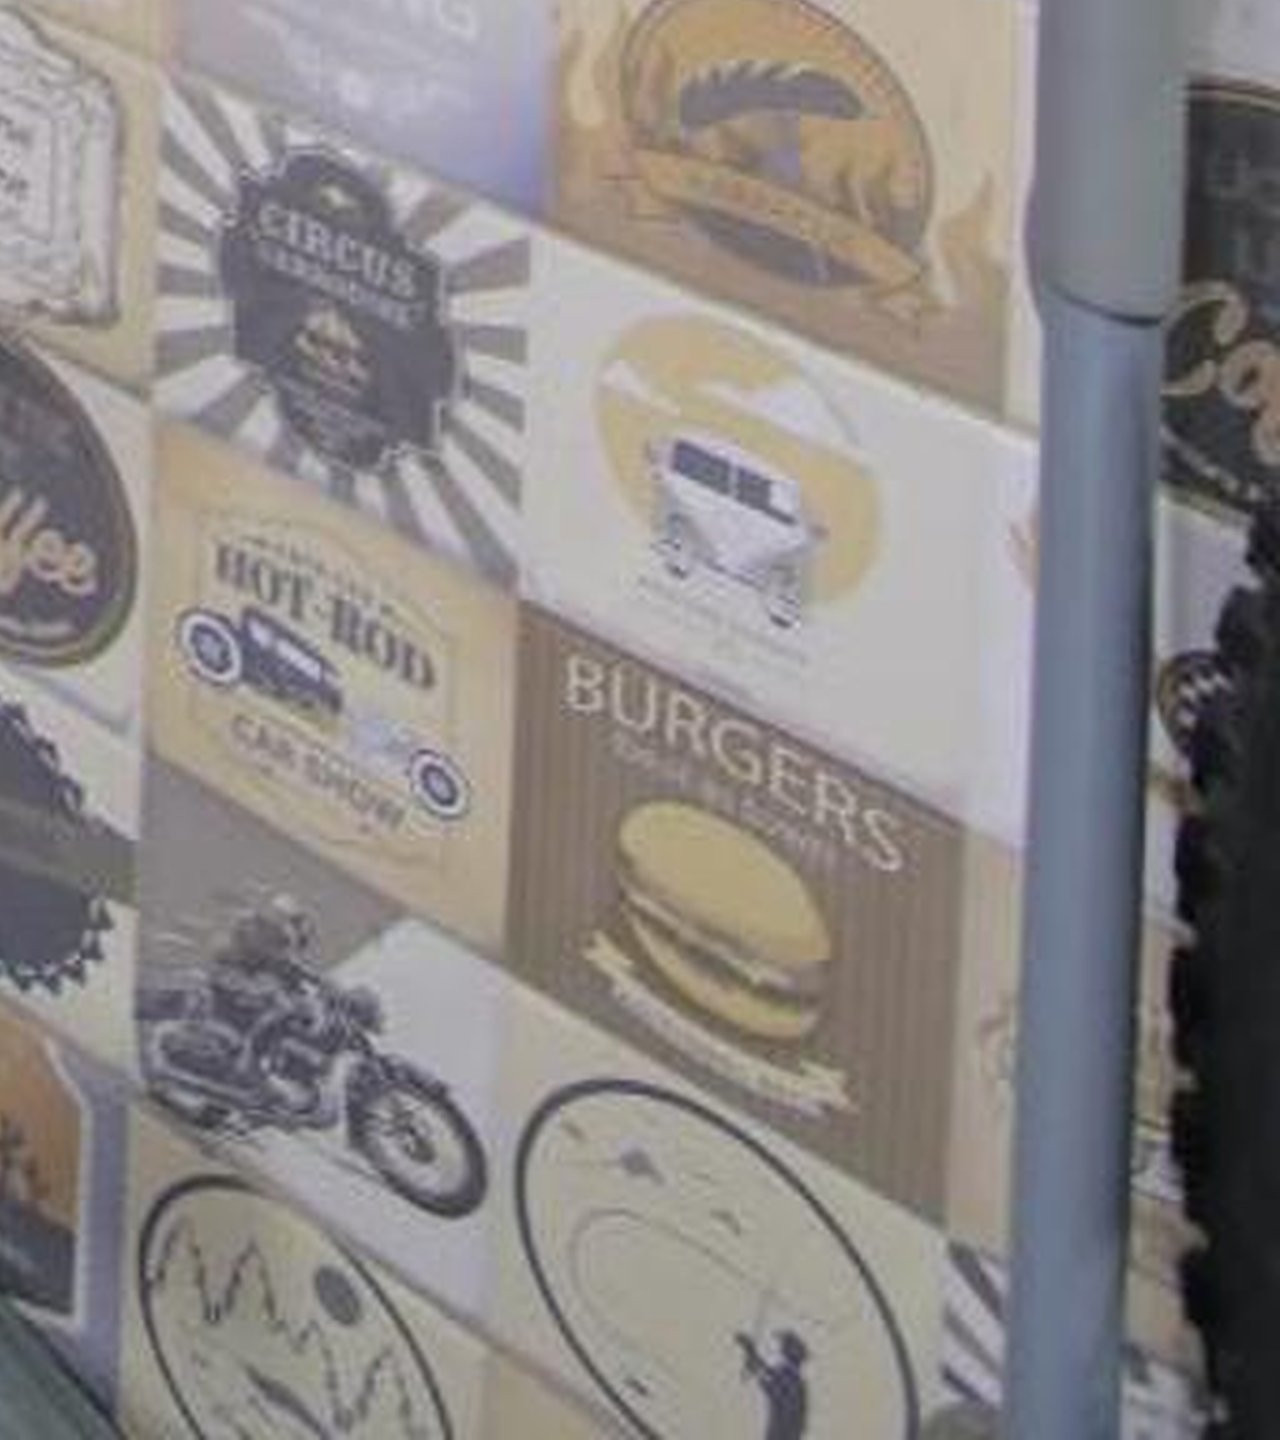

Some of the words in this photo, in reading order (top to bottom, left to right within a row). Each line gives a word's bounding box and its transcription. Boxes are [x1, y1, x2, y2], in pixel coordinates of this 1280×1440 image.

[257, 202, 420, 302] CIRCUS
[232, 712, 296, 770] CAR
[302, 746, 407, 830] SHOW
[560, 652, 904, 872] BURGERS
